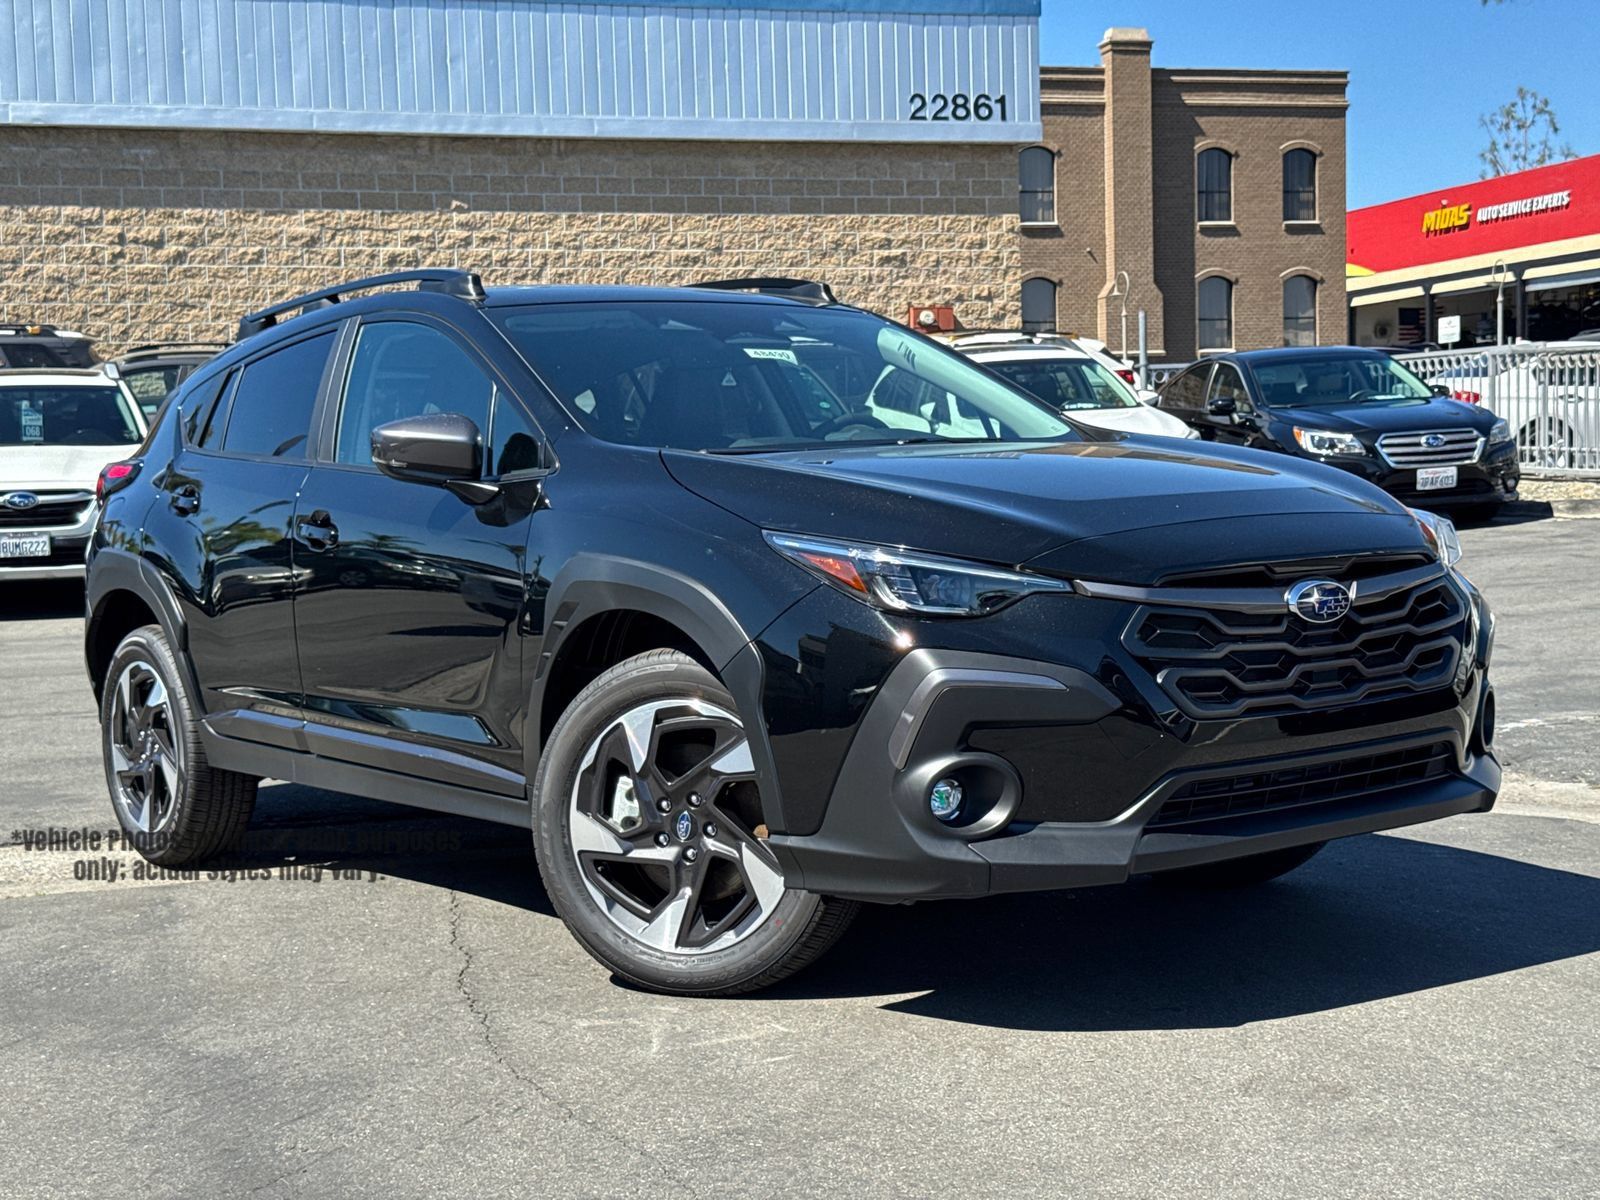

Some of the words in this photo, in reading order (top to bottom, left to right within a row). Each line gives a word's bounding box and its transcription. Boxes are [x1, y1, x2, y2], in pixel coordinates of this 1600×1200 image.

[909, 93, 1006, 121] 22861
[1422, 203, 1471, 232] MIDAS
[1476, 205, 1499, 222] AUTO
[1499, 199, 1532, 217] SERVICE
[1532, 189, 1571, 212] EXPERTS
